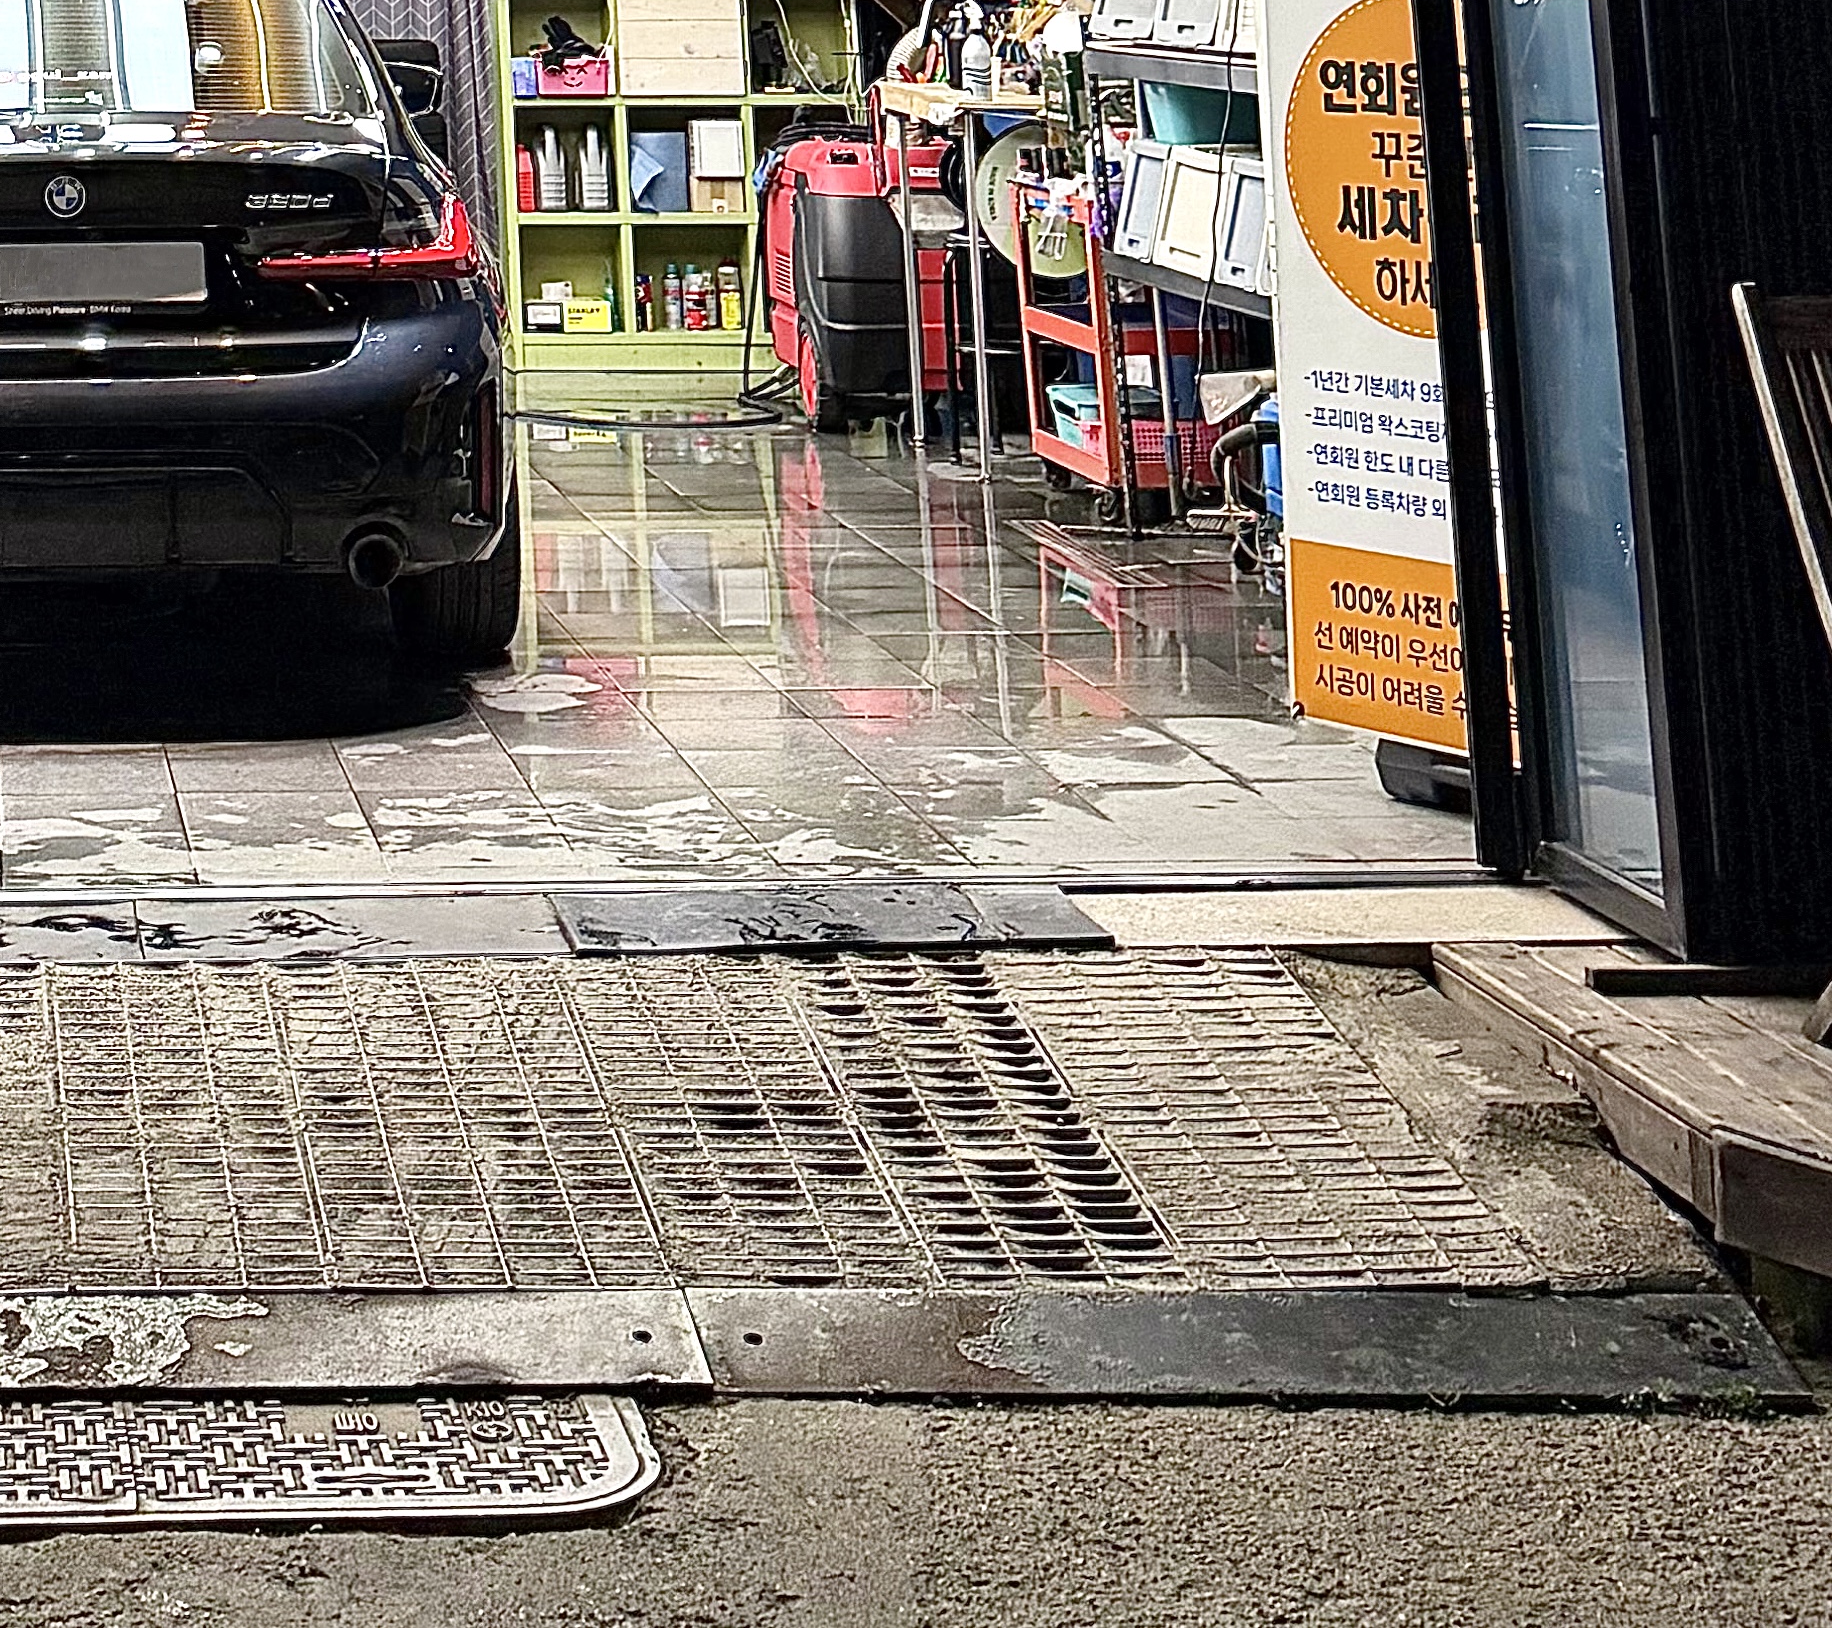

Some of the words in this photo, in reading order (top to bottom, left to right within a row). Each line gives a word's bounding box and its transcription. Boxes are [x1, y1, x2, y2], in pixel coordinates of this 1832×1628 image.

[1354, 374, 1416, 402] 기본세차
[1363, 450, 1396, 474] 한도
[1399, 455, 1414, 477] 내
[1365, 487, 1428, 518] 등록차량
[1432, 498, 1448, 521] 외
[1330, 581, 1396, 619] 100%
[1401, 592, 1443, 629] 사전
[1314, 620, 1334, 651] 선
[1339, 625, 1400, 664] 예약이
[1315, 663, 1376, 702] 시공이
